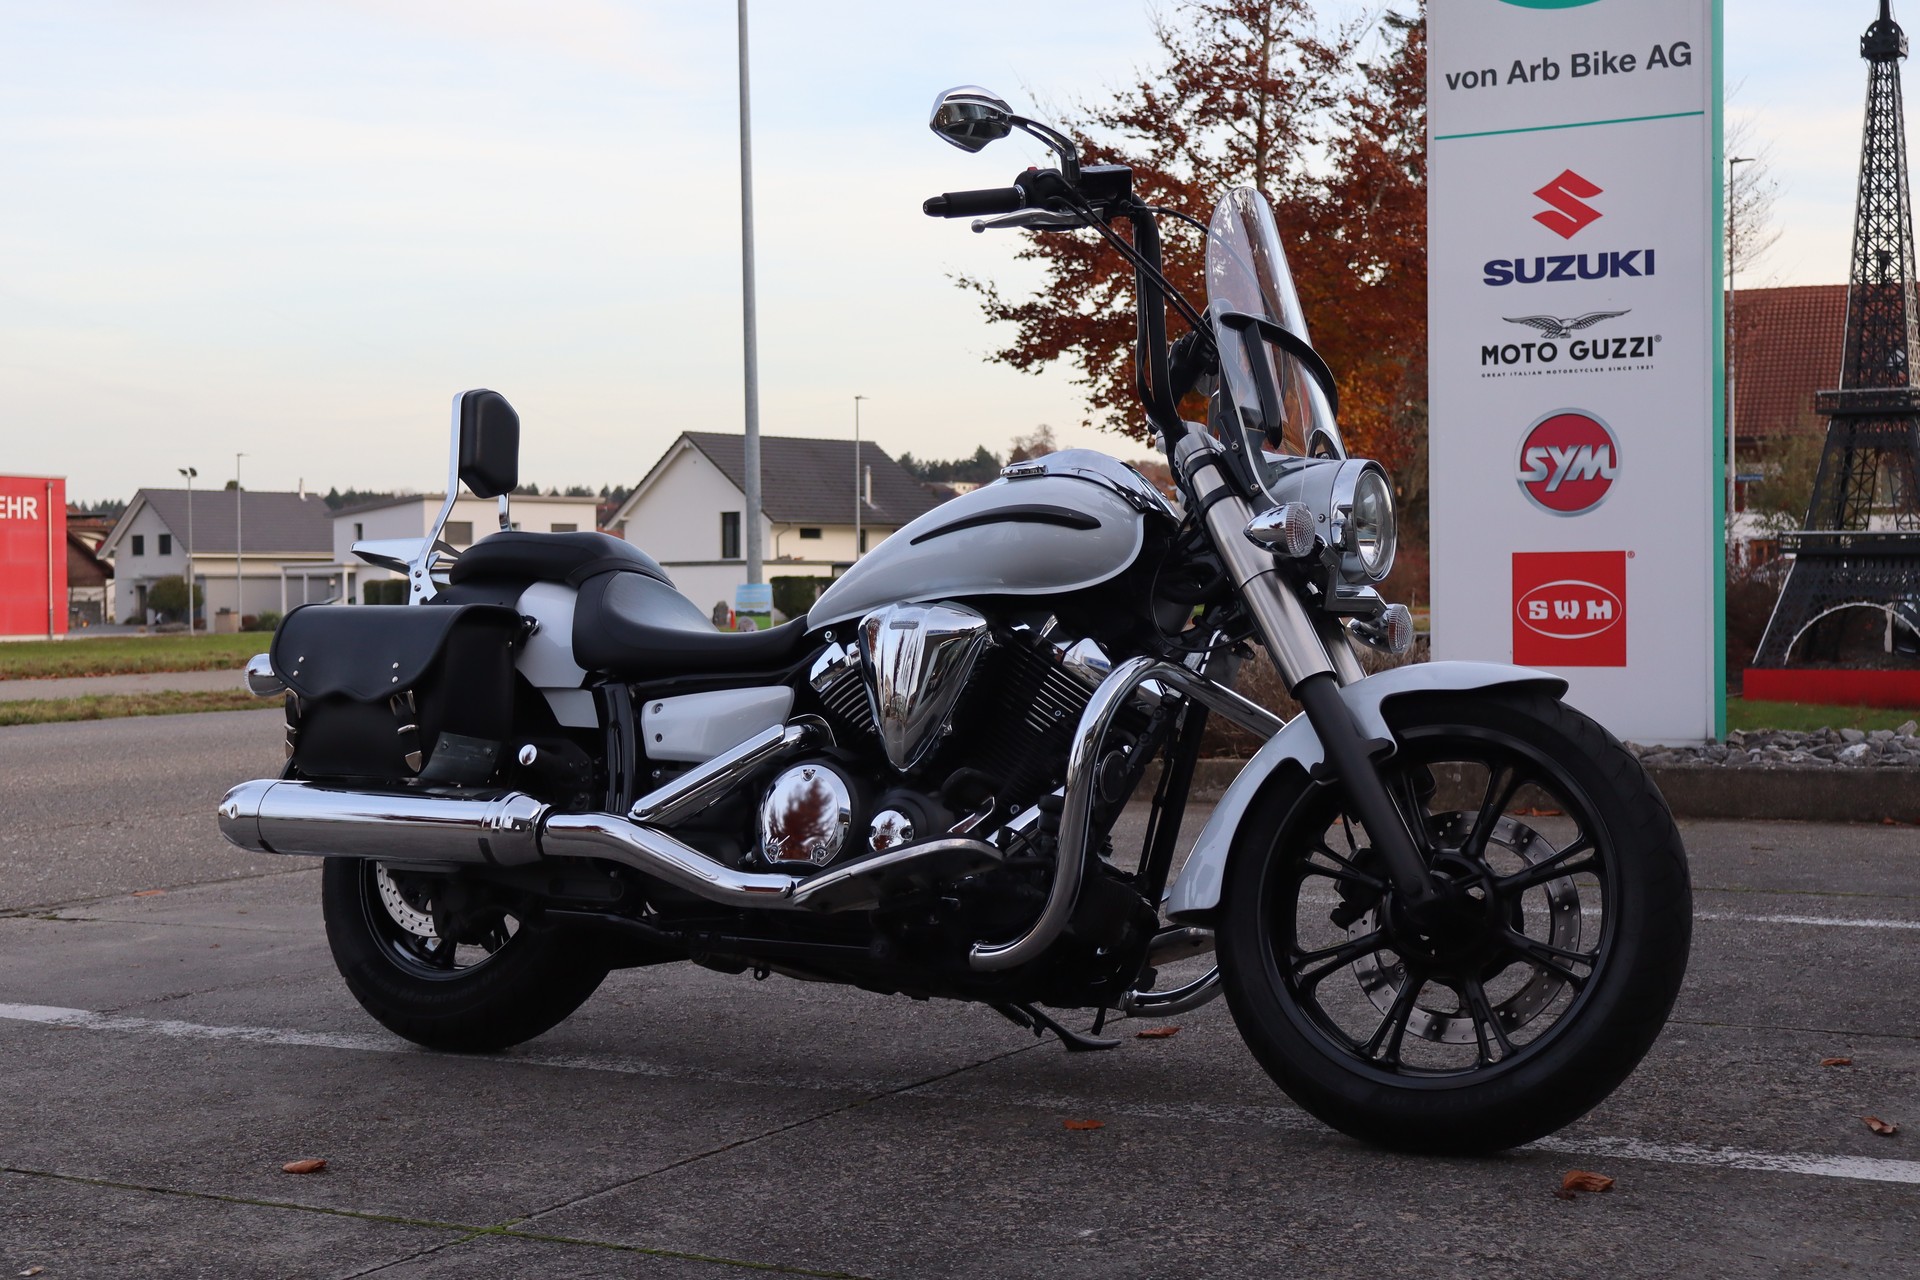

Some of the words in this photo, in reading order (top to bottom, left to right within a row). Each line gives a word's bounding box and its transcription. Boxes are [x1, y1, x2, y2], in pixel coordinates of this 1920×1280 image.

[1445, 67, 1498, 91] von
[1507, 57, 1560, 85] Arb
[1571, 50, 1637, 79] Bike
[1646, 41, 1692, 70] AG
[1483, 249, 1655, 286] SUZUKI
[1481, 342, 1558, 366] MOTO
[1546, 367, 1604, 375] MOTORCYCLES
[1517, 444, 1617, 492] SYM
[1528, 599, 1613, 621] SWM
